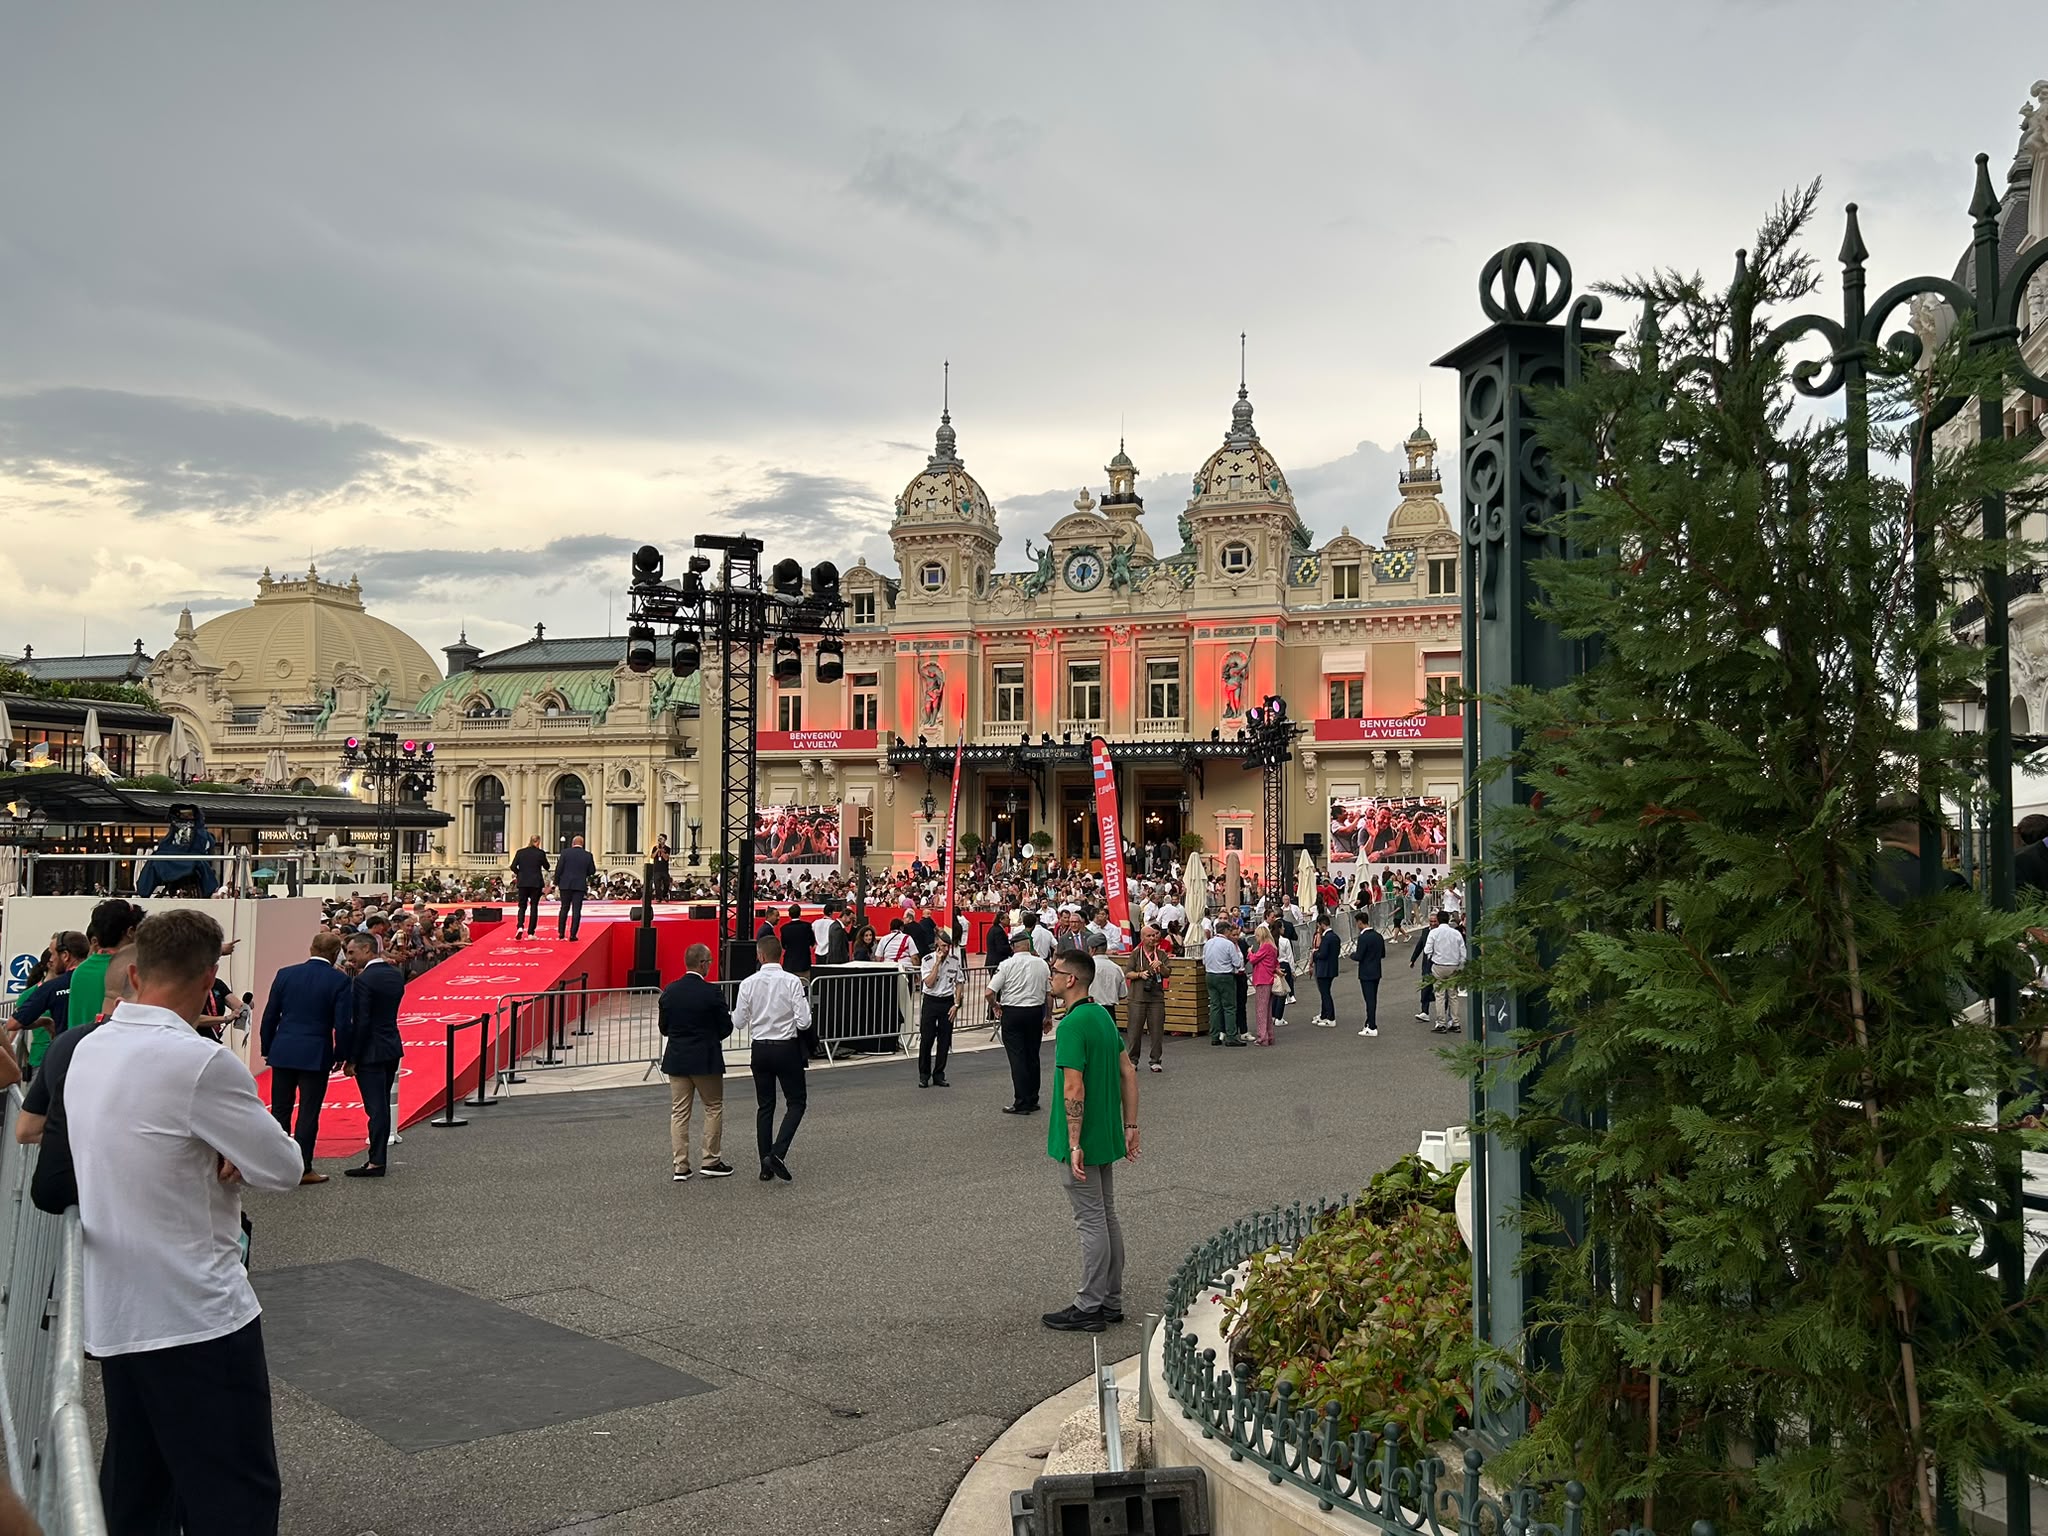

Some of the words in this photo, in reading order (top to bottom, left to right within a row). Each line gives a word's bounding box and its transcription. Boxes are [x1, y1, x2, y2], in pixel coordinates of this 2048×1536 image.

[1364, 730, 1378, 738] LA
[1381, 729, 1421, 737] VUELTA
[793, 741, 804, 749] LA
